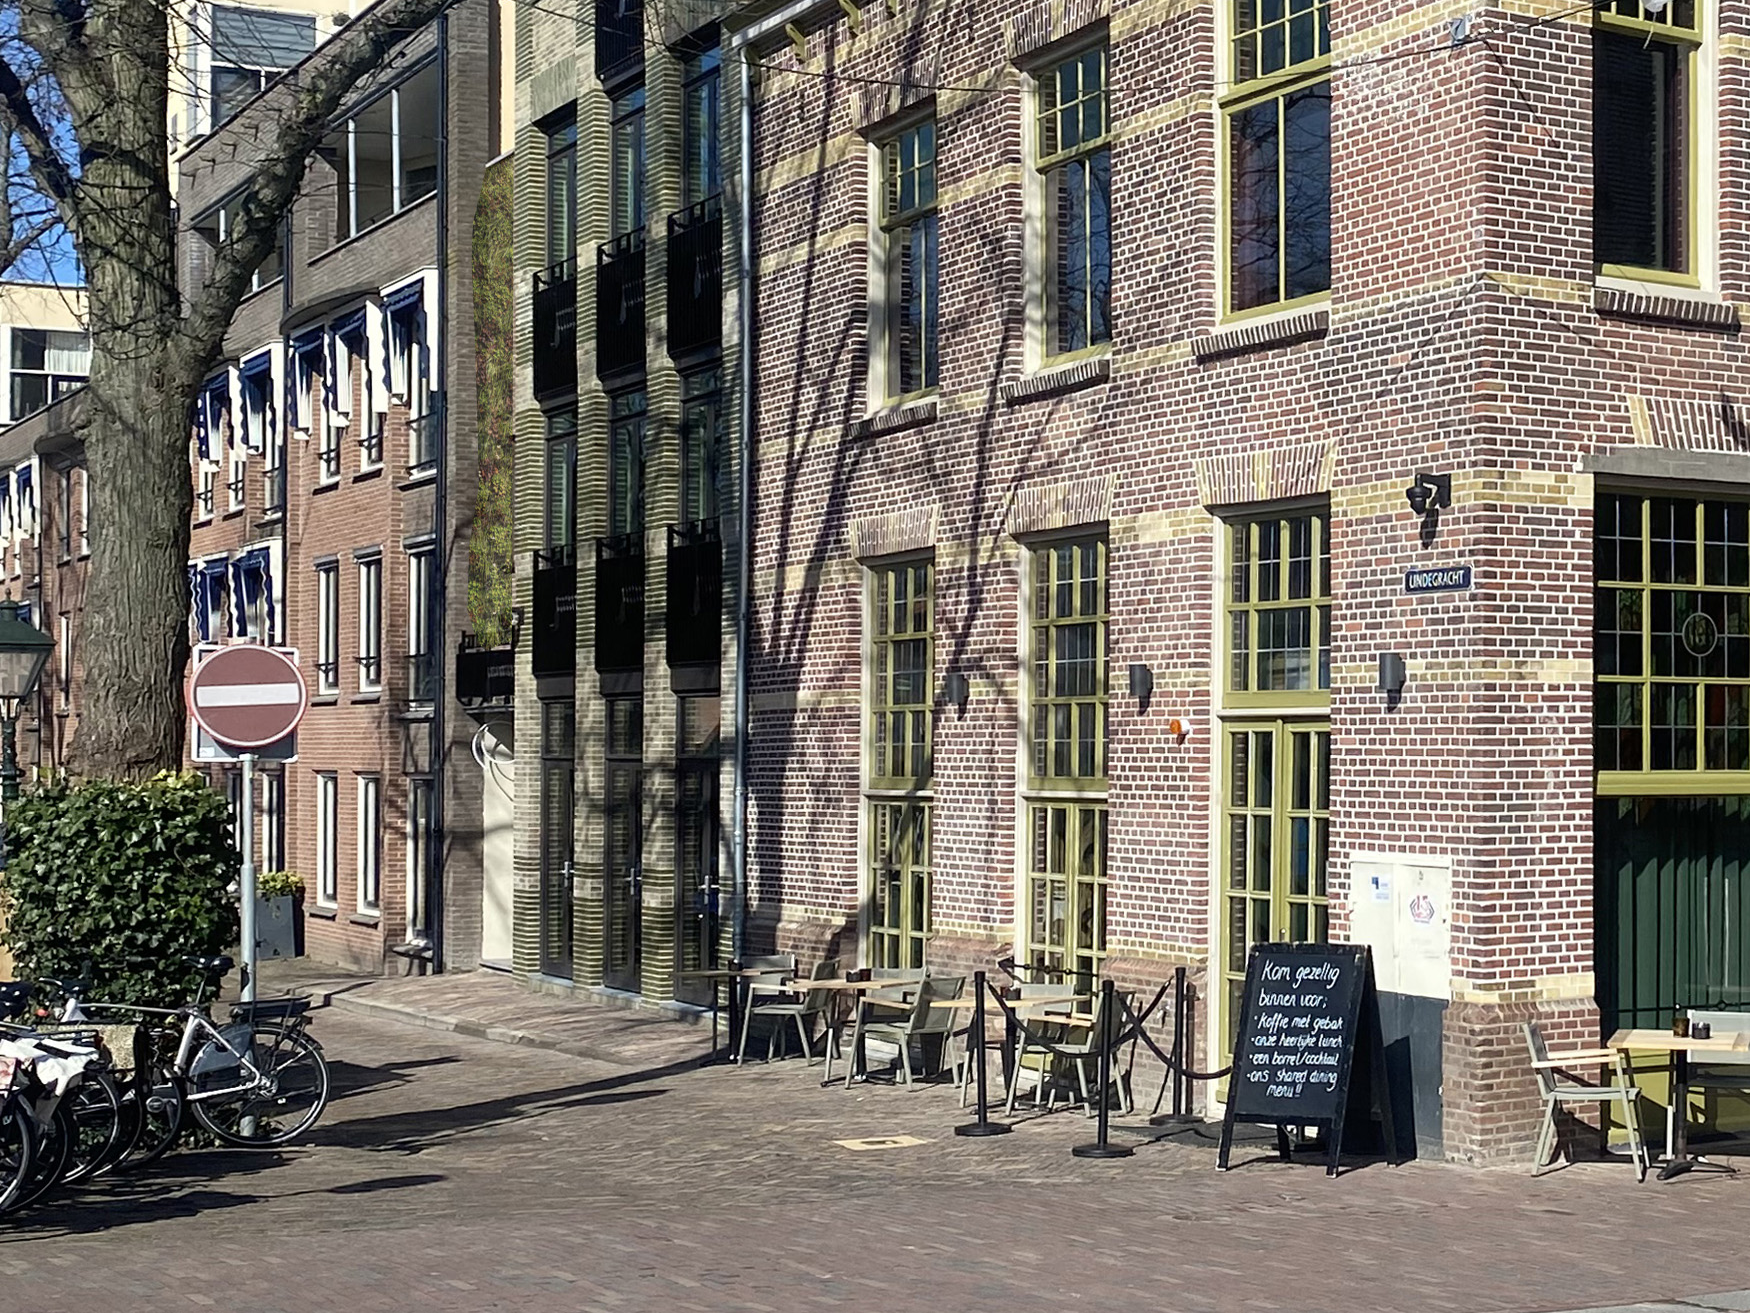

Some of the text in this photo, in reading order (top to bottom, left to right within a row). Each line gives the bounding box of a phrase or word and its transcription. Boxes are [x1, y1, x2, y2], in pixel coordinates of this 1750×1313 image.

[1261, 959, 1340, 989] Kom gezellig
[1259, 988, 1296, 1006] binnen
[1291, 1014, 1310, 1028] met
[1311, 1014, 1344, 1035] gebak
[1254, 1034, 1277, 1047] onze
[1317, 1033, 1344, 1048] lunch
[1252, 1053, 1270, 1065] een
[1250, 1070, 1270, 1082] ons
[1309, 1070, 1337, 1092] dining
